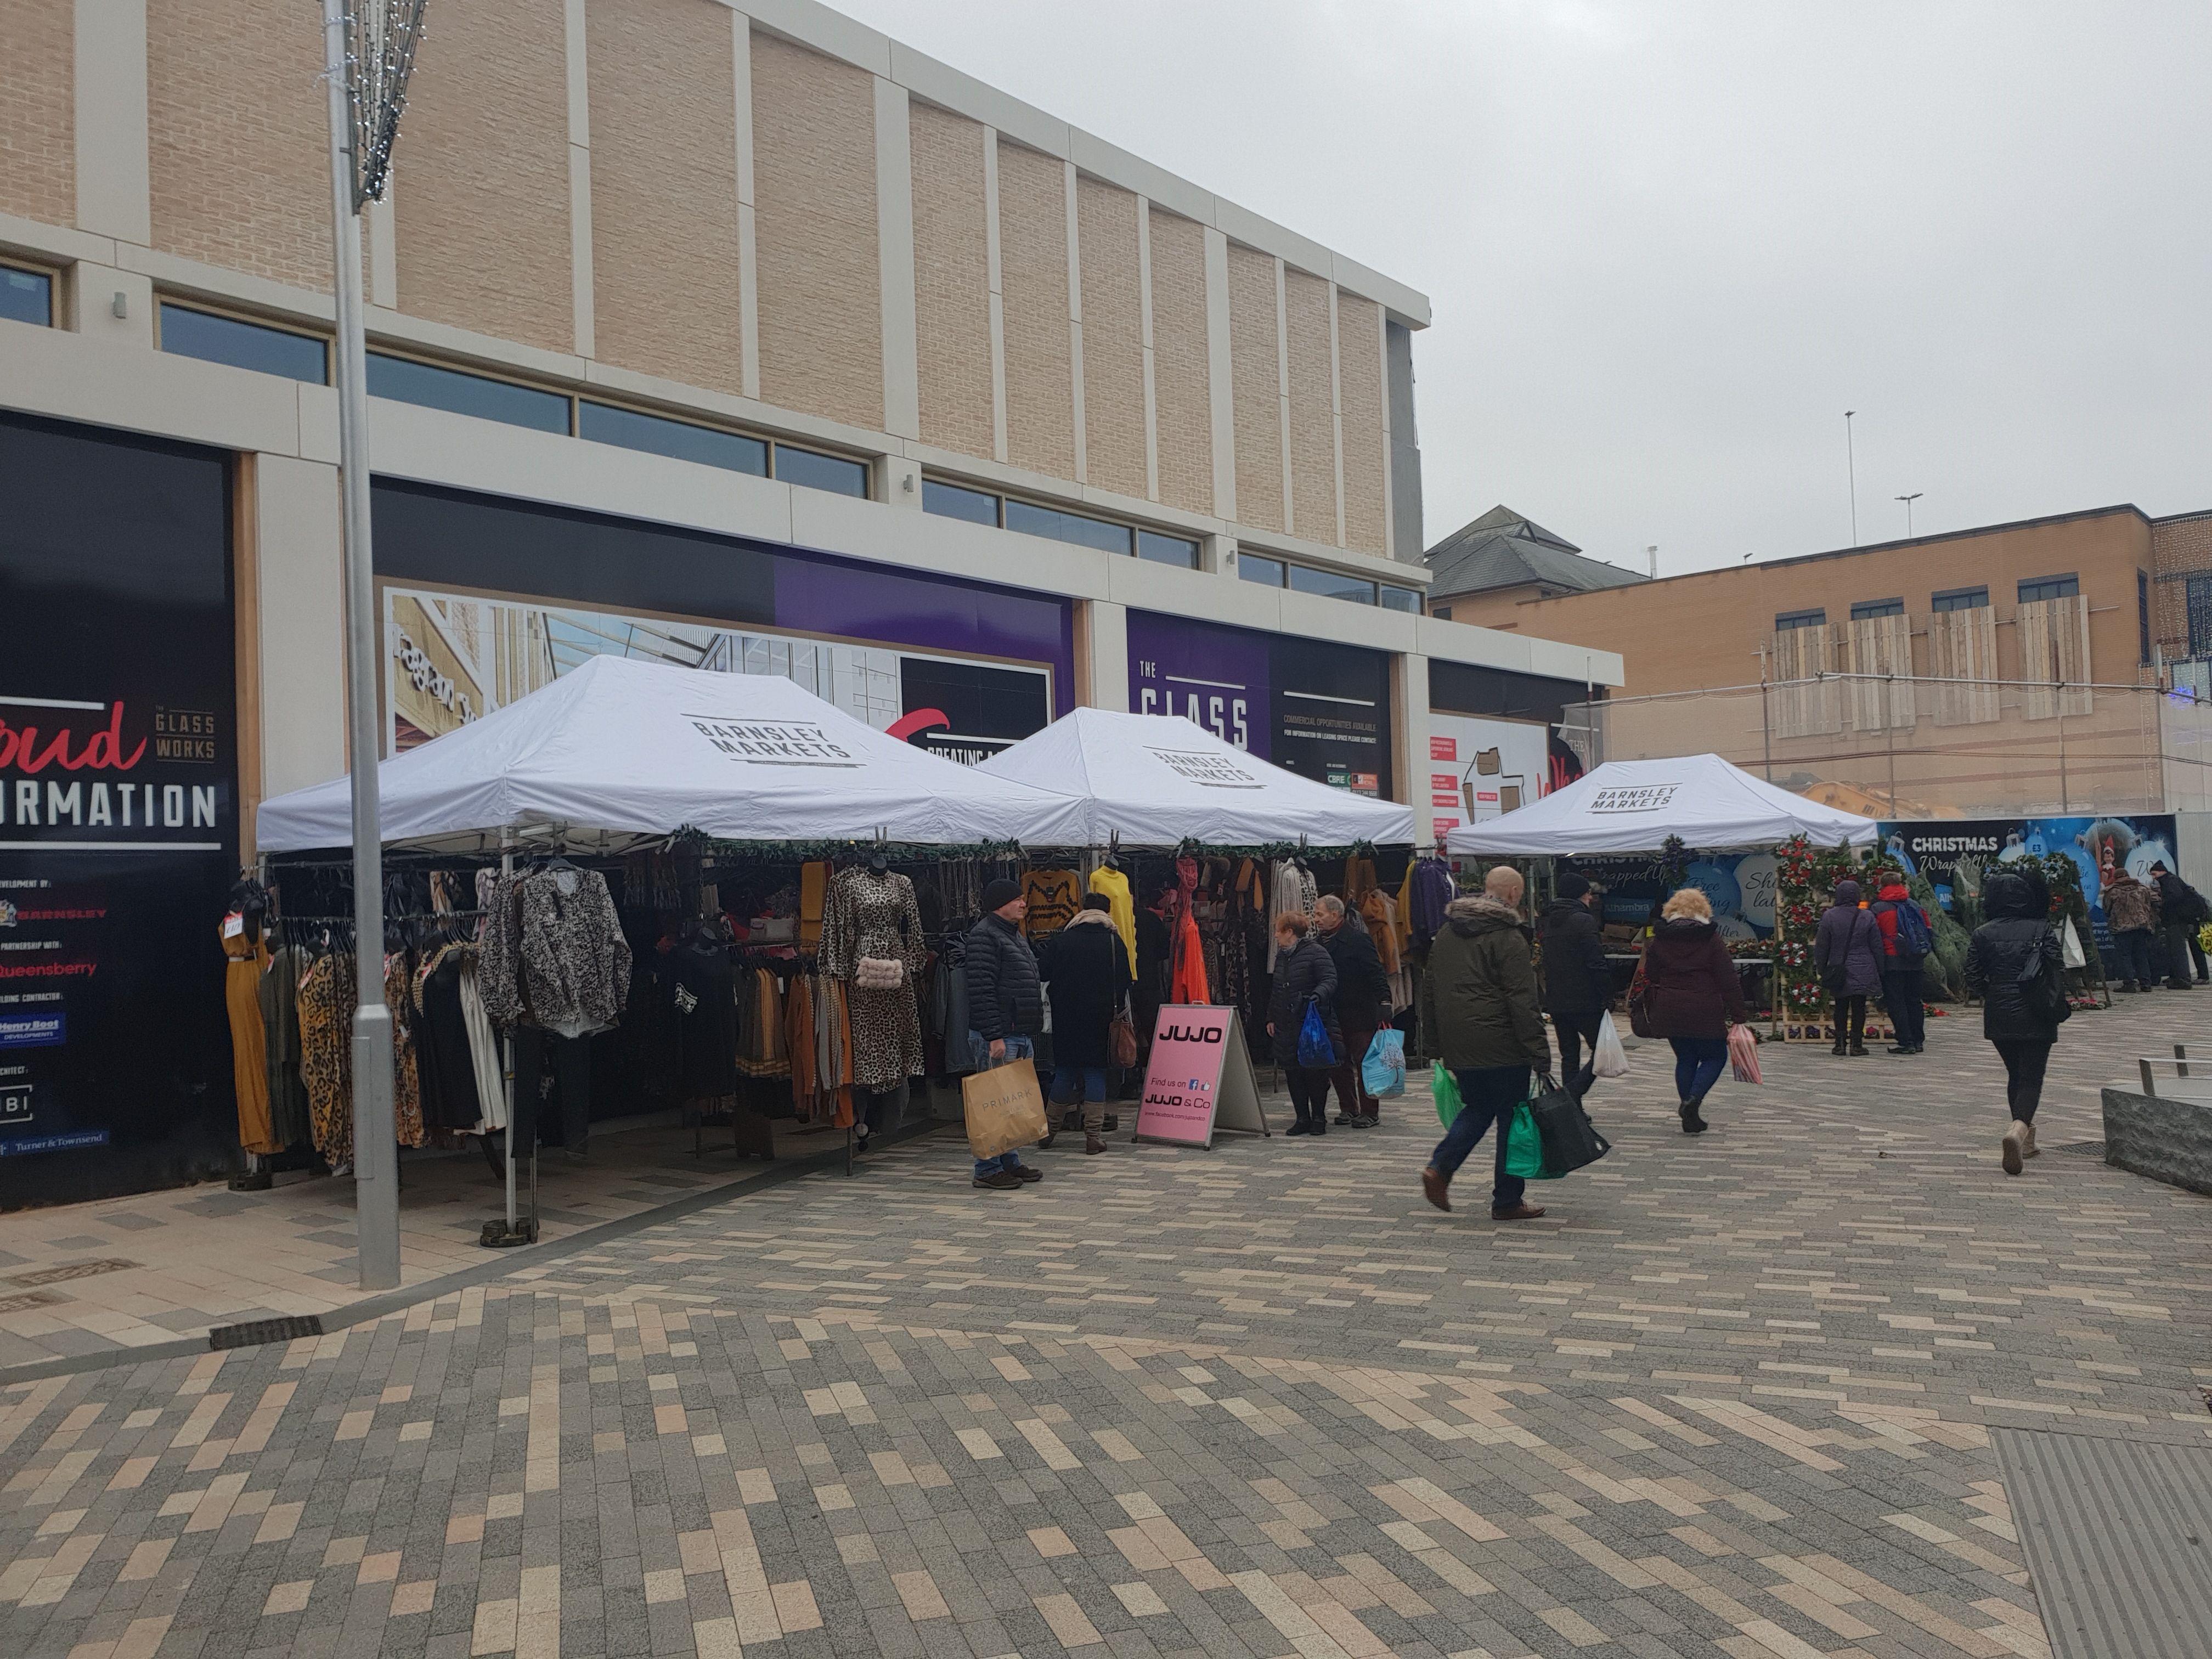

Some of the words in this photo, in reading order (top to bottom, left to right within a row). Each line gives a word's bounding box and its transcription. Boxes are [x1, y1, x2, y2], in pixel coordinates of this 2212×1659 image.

[1139, 661, 1156, 678] THE
[155, 714, 215, 734] GLASS
[1283, 715, 1316, 726] COMMERCIAL
[1317, 718, 1352, 730] OPPORTUNITIES
[1352, 722, 1376, 731] AVAILABLE
[691, 721, 830, 742] BARNSLEY
[156, 739, 215, 759] WORKS
[709, 739, 851, 758] MARKETS
[1568, 740, 1584, 752] THE
[1152, 752, 1235, 768] BARNSLEY
[1170, 765, 1255, 781] MARKETS
[1327, 775, 1345, 784] CBRE
[1597, 787, 1679, 799] BARNSLEY
[0, 780, 216, 827] RMATION
[1590, 796, 1672, 809] MARKETS
[1912, 837, 1998, 852] CHRISTMAS
[1688, 877, 1720, 891] Free
[17, 910, 106, 920] BARNSLEY
[1, 941, 42, 951] PARTNERSHIP
[32, 1019, 59, 1030] Boot
[4, 1031, 54, 1040] DEVELOPMENTS
[1159, 1025, 1222, 1043] JUJO
[1150, 1077, 1166, 1086] Find
[982, 1089, 1032, 1111] PRIMARK
[1145, 1094, 1182, 1106] JUJO
[1194, 1098, 1211, 1109] Co
[15, 1141, 47, 1152] Turner
[48, 1139, 56, 1148] &
[57, 1133, 103, 1147] Townsend
